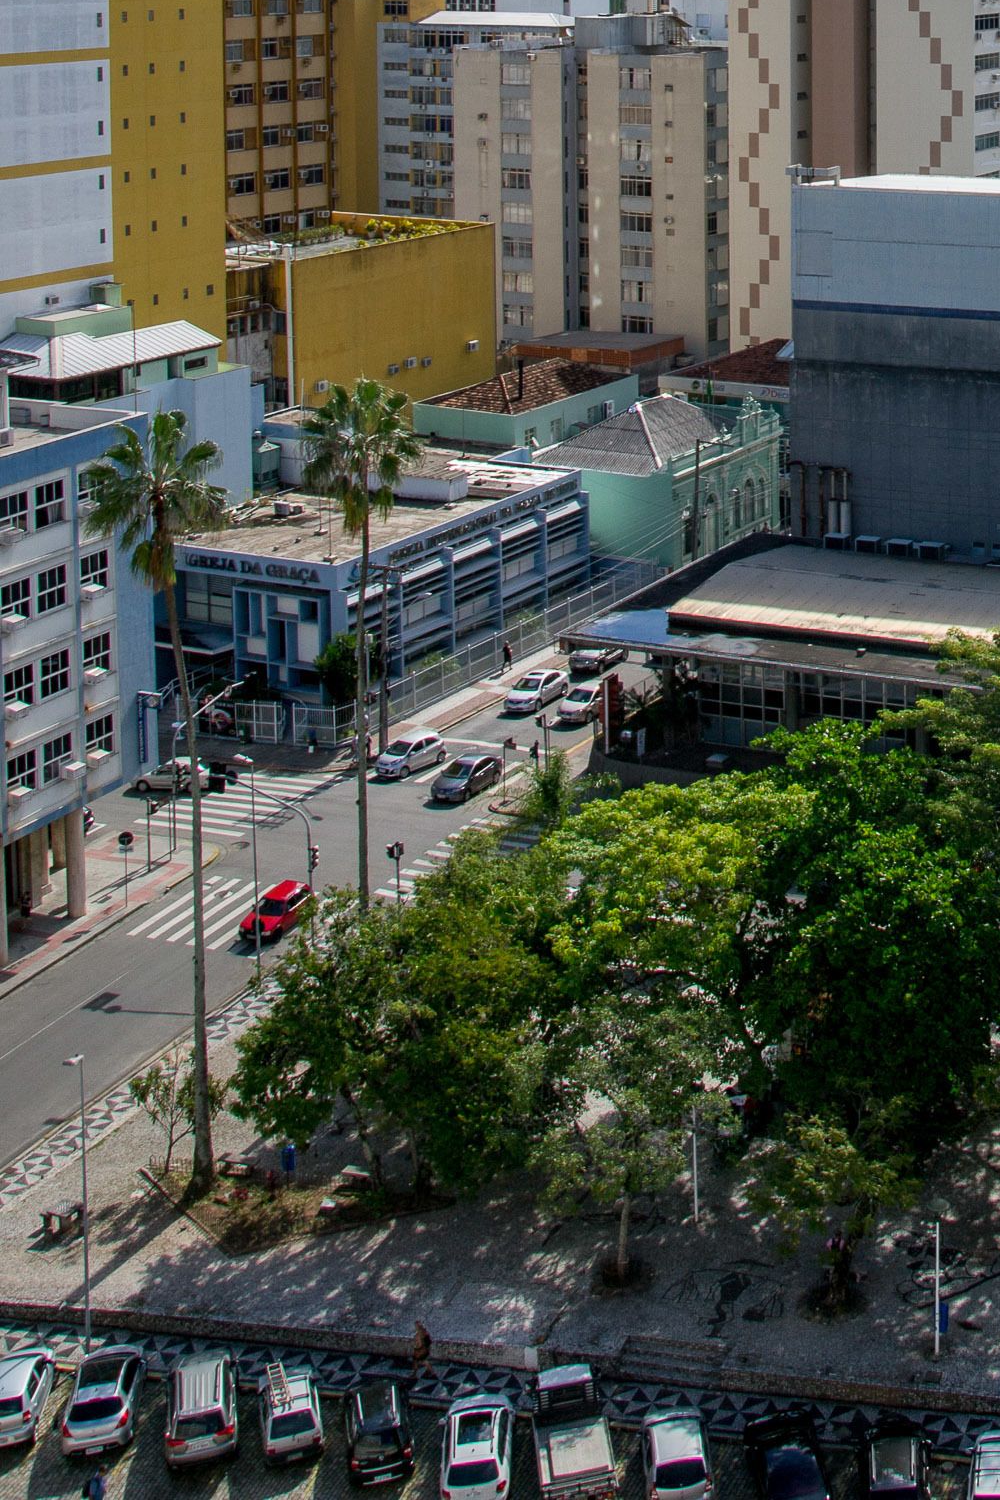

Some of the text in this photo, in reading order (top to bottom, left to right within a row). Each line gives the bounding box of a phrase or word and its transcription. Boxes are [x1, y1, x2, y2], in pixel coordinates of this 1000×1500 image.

[184, 552, 321, 584] IGREJA DA GRAÇA
